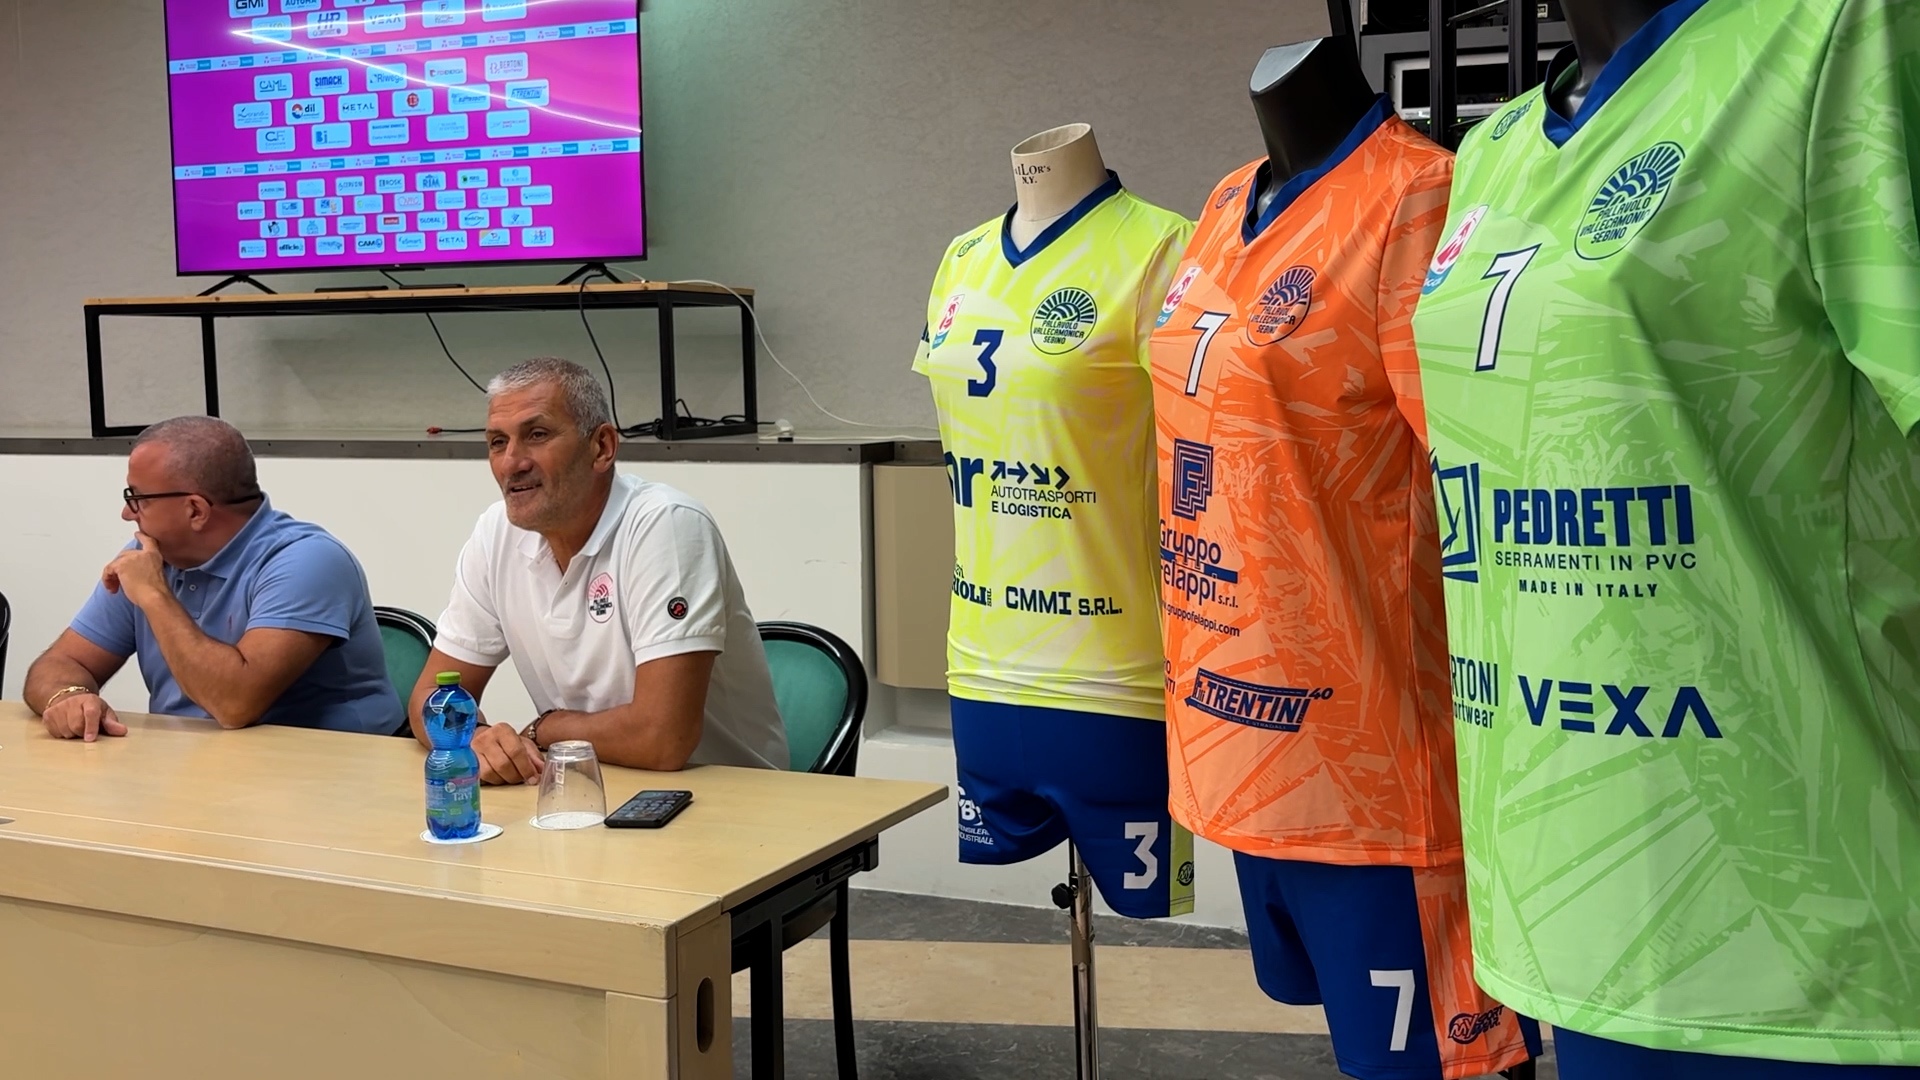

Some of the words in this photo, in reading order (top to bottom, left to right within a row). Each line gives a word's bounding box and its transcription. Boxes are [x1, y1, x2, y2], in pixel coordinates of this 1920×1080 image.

[342, 103, 375, 113] METAL
[1579, 209, 1652, 237] VALLECAMONIC
[1595, 197, 1652, 221] PALLAVOLO
[1590, 227, 1627, 244] SEBINO
[1474, 243, 1543, 372] 7
[1042, 320, 1078, 329] PALLAVOLO
[1043, 336, 1066, 344] SEBINO
[1184, 310, 1231, 398] 7
[967, 328, 1005, 398] 3
[990, 485, 1097, 504] AUTOTRASPORTI
[991, 501, 999, 513] E
[1001, 502, 1072, 520] LOGISTICA
[1493, 484, 1695, 547] PEDRETTI
[1159, 519, 1222, 570] Gruppo
[1495, 551, 1600, 570] SERRAMENTI
[1610, 555, 1633, 571] IN
[1646, 552, 1697, 570] PVC
[1005, 586, 1072, 615] CMMI
[1078, 597, 1123, 616] S.R.L.
[1217, 594, 1239, 608] s.r.l.
[1519, 579, 1558, 594] MADE
[1566, 582, 1584, 596] IN
[1597, 583, 1658, 598] ITALY
[1206, 681, 1312, 724] TRENTINI
[1308, 687, 1334, 700] 40
[1517, 675, 1724, 739] VEXA
[1123, 821, 1159, 889] 3
[1369, 969, 1416, 1052] 7
